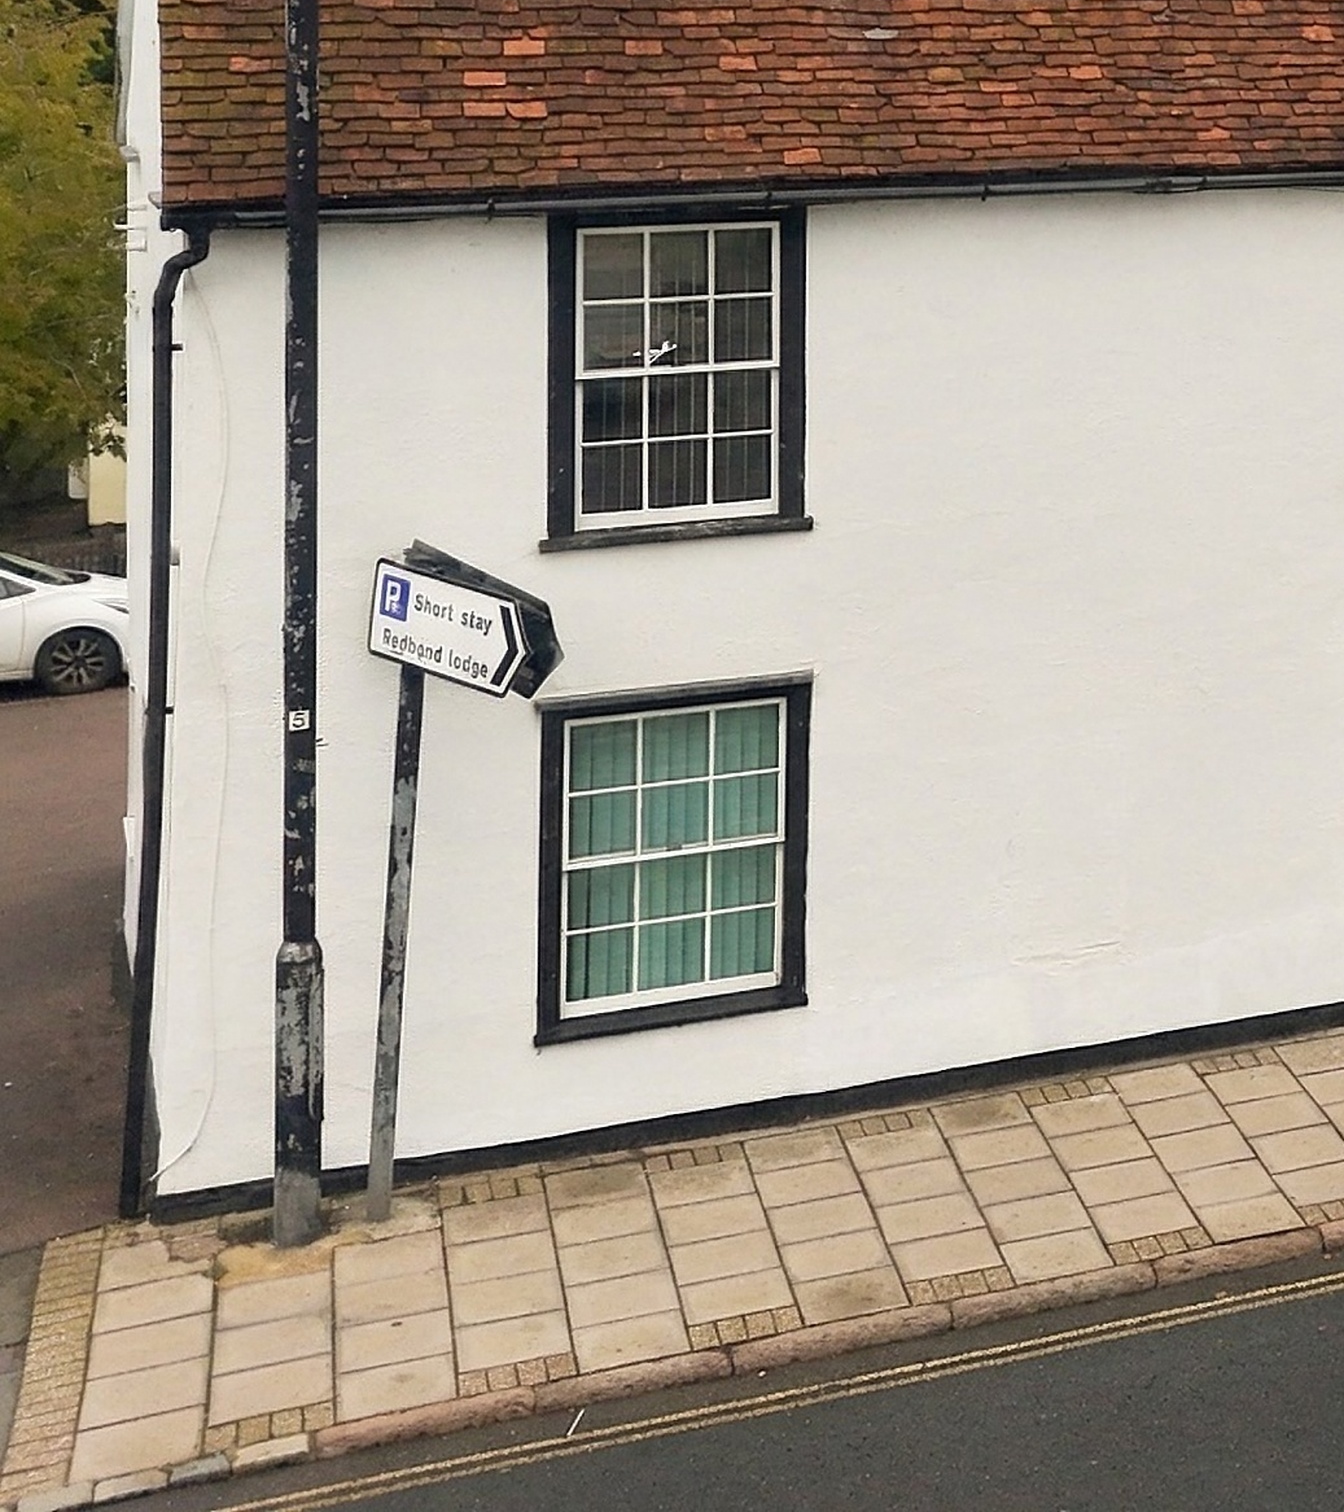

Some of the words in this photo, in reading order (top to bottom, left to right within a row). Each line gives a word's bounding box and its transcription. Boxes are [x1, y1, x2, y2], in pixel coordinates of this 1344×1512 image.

[414, 593, 453, 622] Short
[461, 610, 492, 636] stay
[449, 649, 489, 679] lodge
[292, 713, 305, 728] 5
